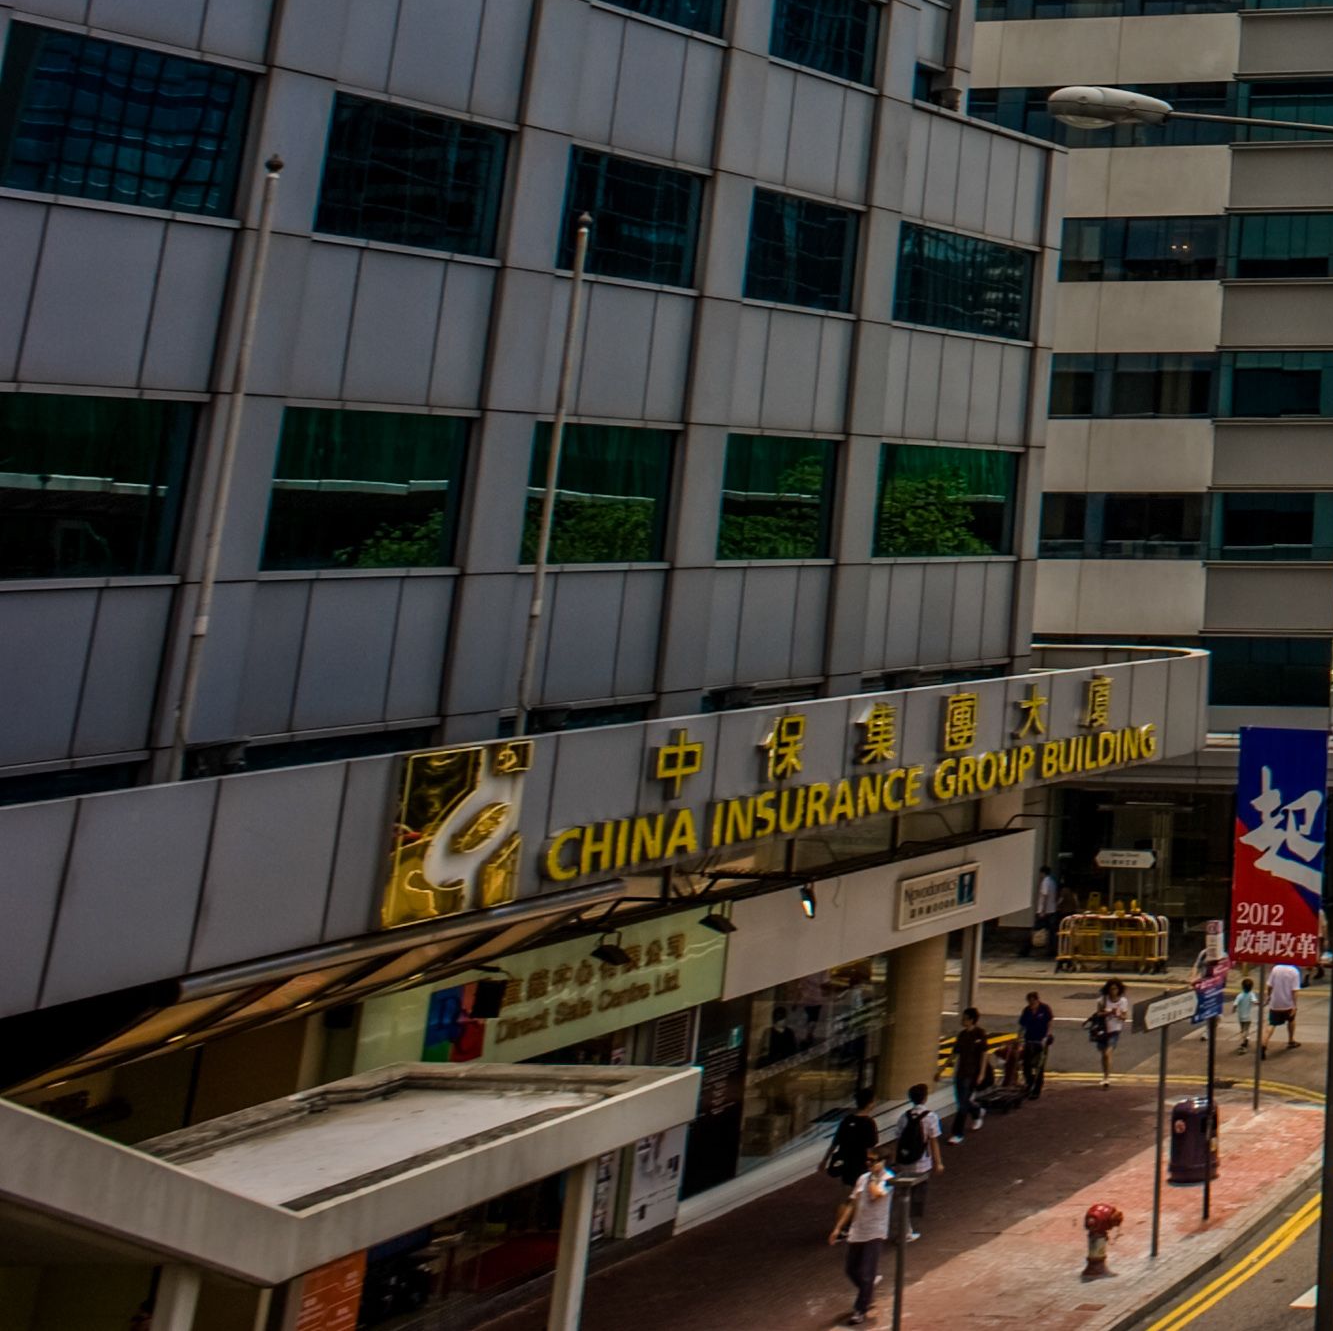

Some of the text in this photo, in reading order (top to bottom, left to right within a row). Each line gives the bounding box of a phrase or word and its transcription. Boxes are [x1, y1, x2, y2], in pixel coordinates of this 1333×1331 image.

[656, 674, 1114, 798] 中保集團大廈
[546, 723, 1157, 882] CHINA INSURANCE GROUP BUILDING
[1239, 765, 1324, 896] 起
[1234, 929, 1318, 960] 政制改革
[1236, 902, 1285, 927] 2012
